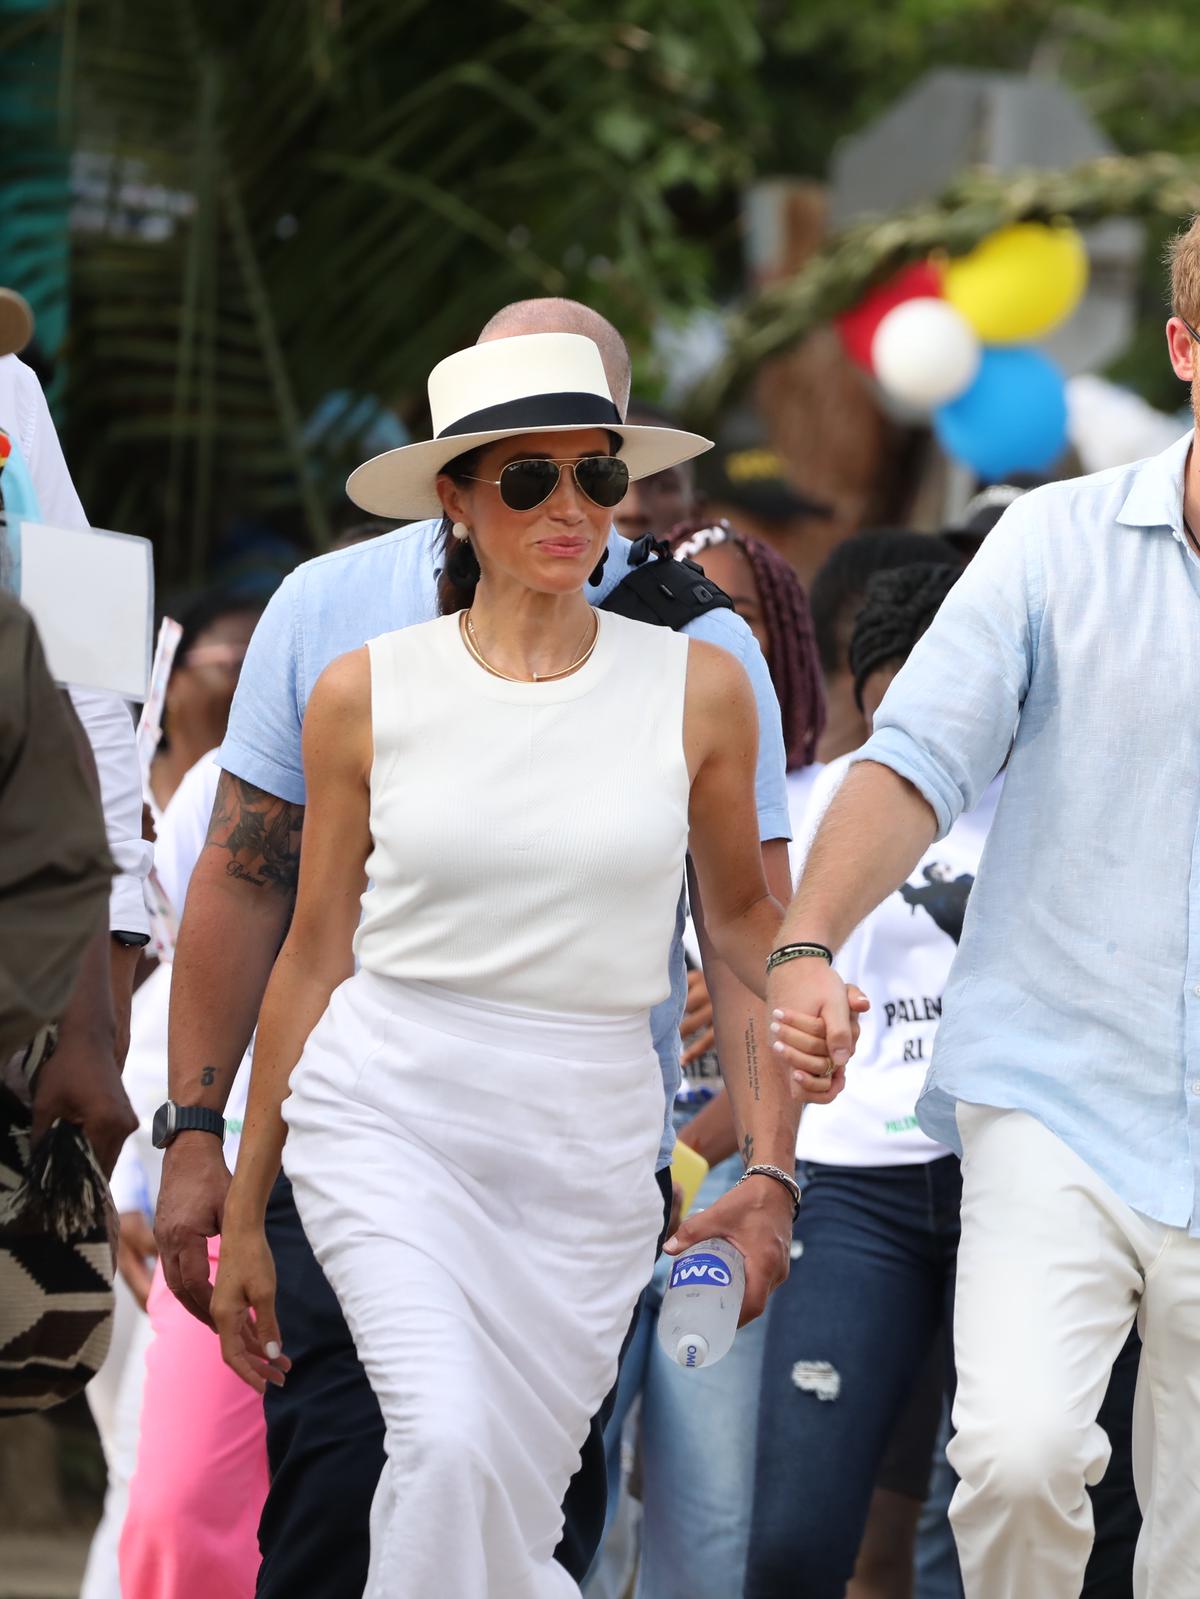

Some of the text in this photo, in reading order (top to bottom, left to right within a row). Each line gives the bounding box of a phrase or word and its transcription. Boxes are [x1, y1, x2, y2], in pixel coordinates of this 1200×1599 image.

[903, 1038, 924, 1062] RI
[673, 1265, 730, 1286] OMI
[686, 1345, 697, 1368] OMI
